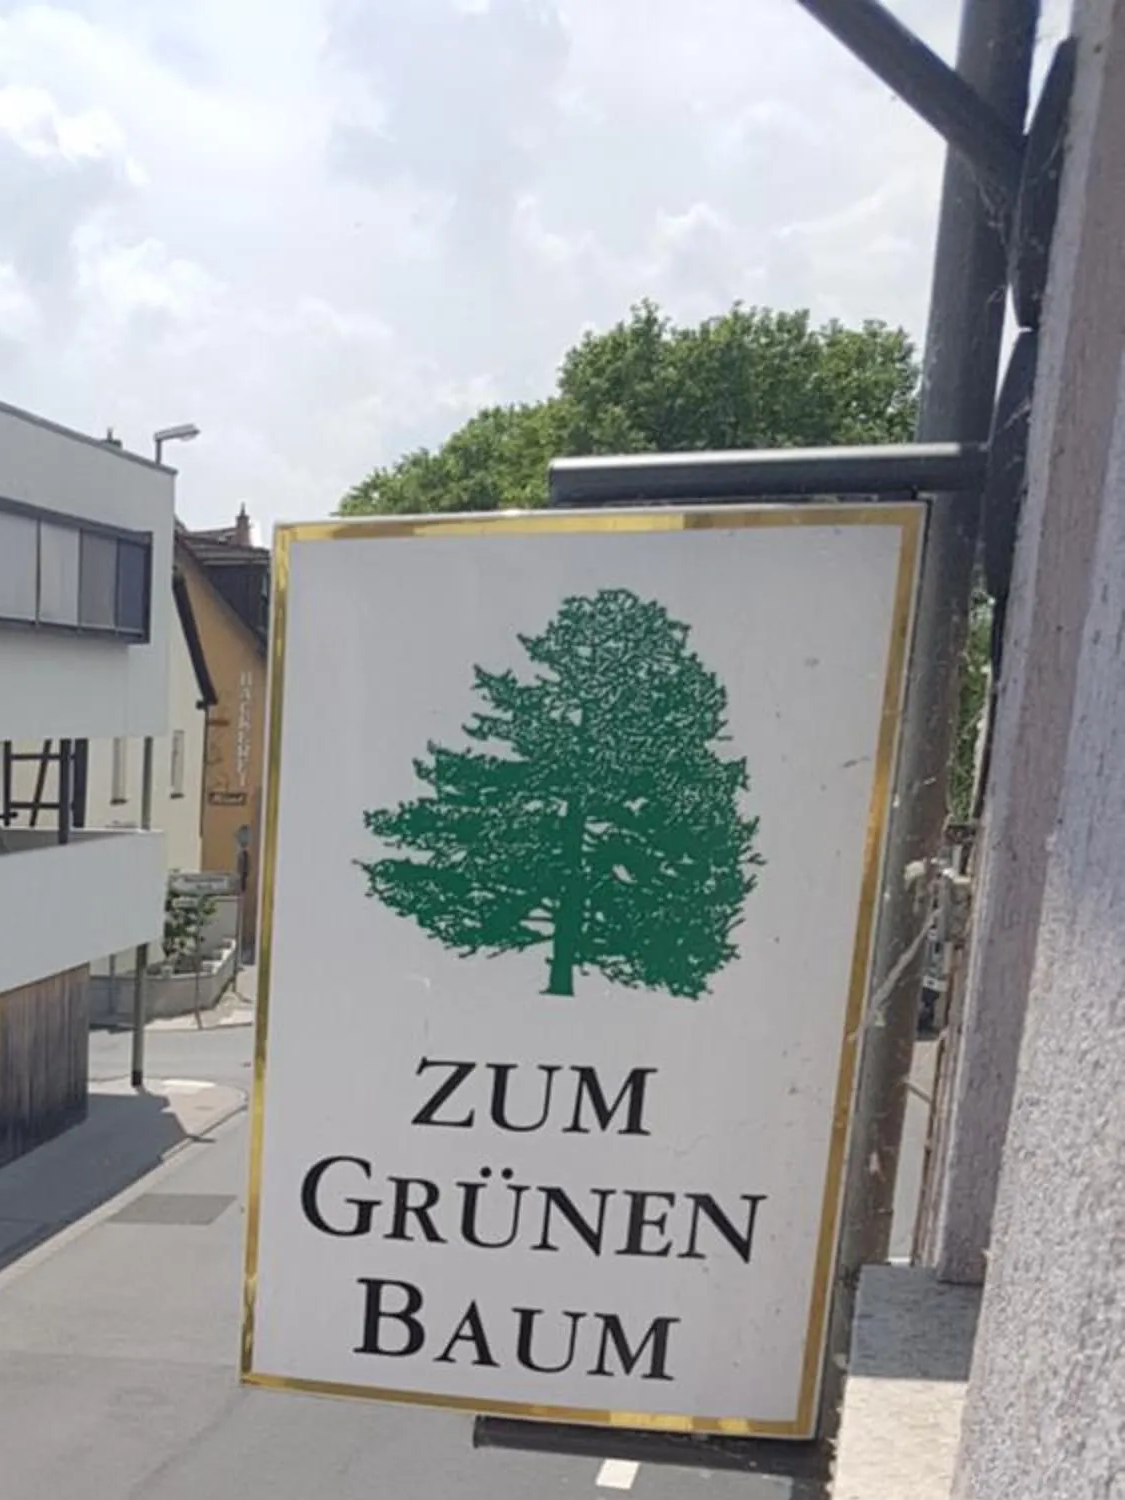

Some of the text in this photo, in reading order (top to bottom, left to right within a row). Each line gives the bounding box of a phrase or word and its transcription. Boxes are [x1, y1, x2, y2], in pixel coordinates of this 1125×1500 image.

[411, 1056, 658, 1136] ZUM
[300, 1155, 768, 1264] GRÜNEN
[353, 1277, 680, 1382] BAUM
